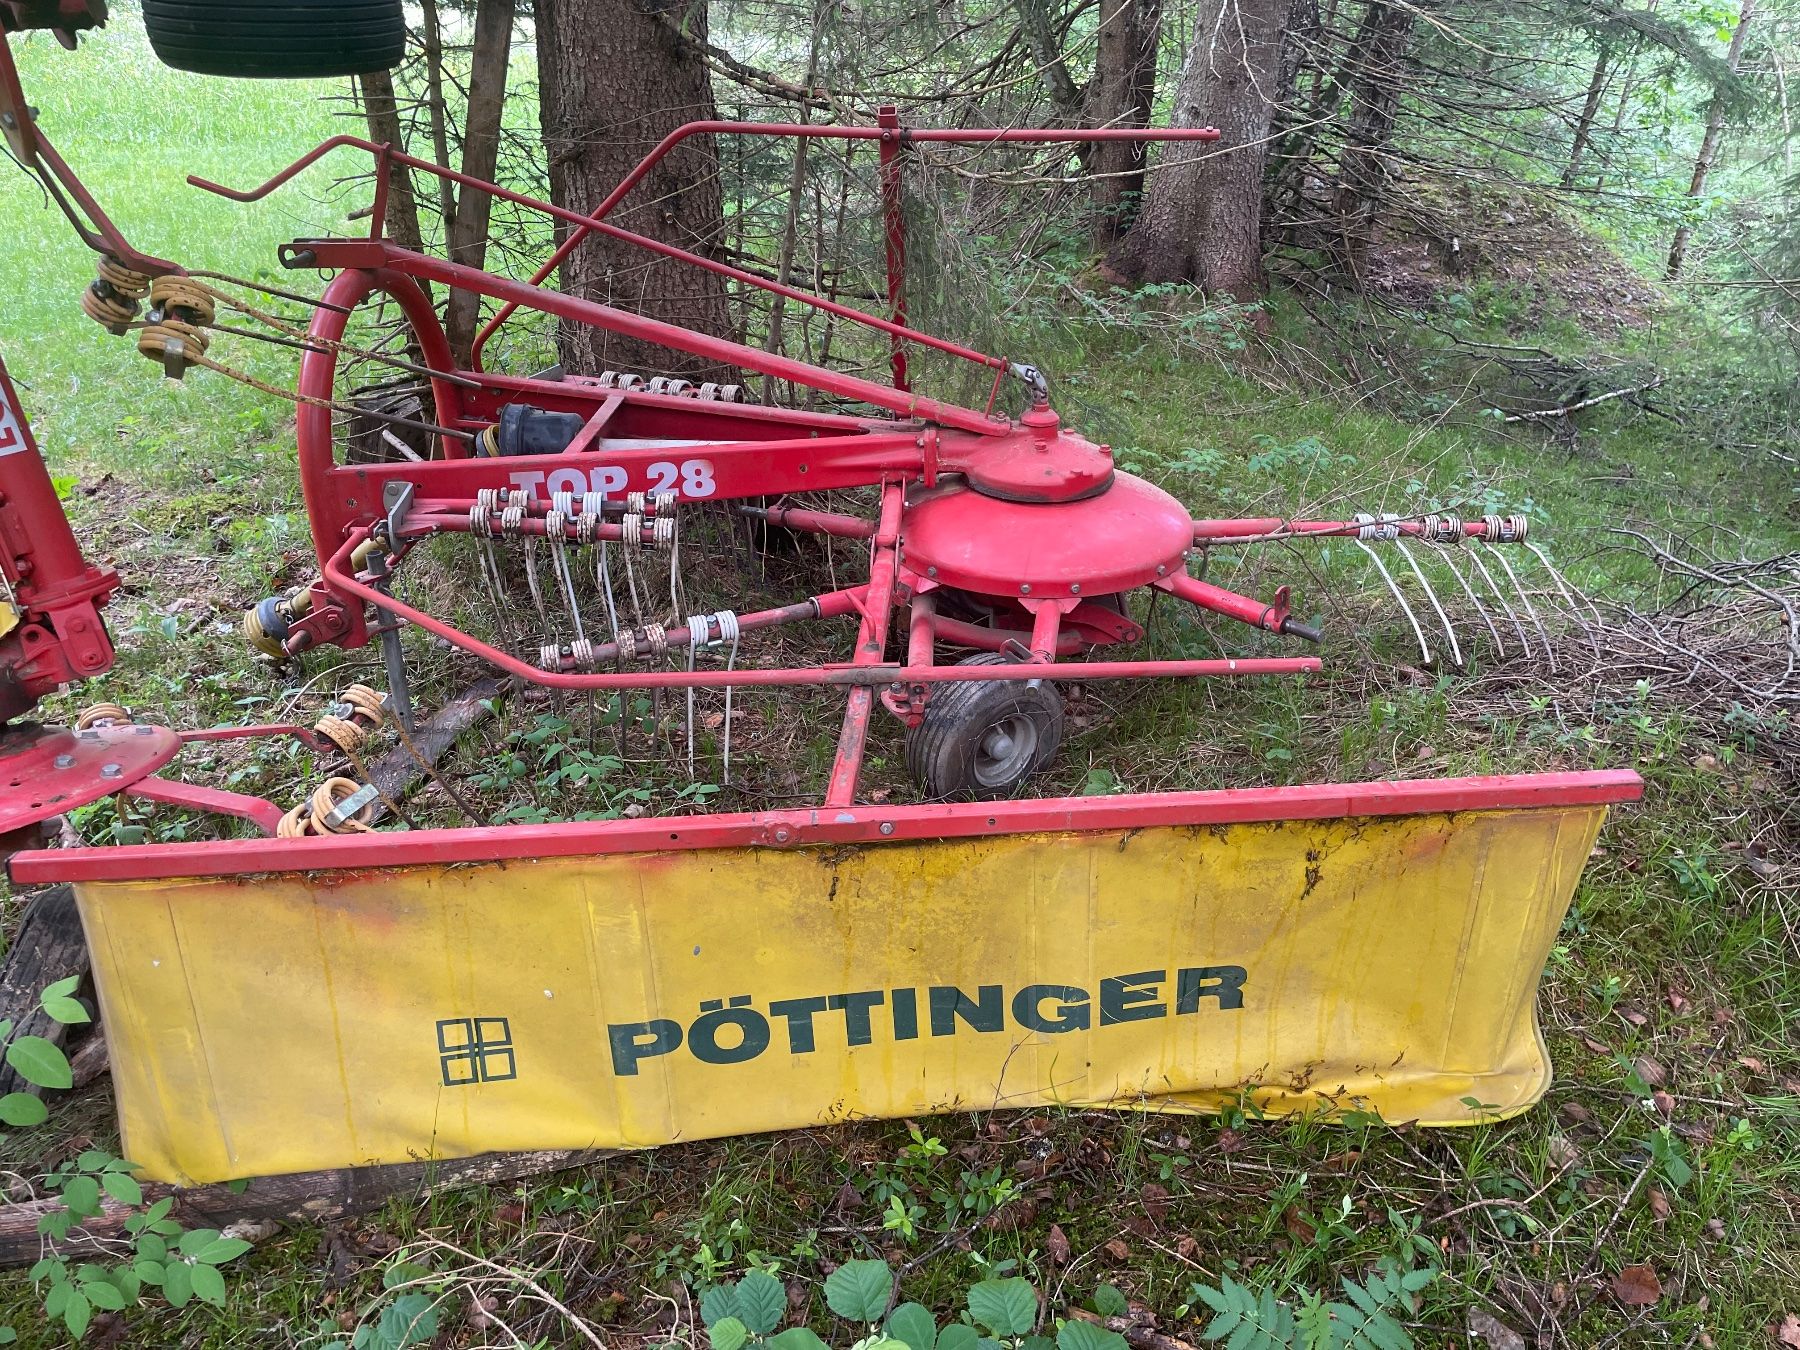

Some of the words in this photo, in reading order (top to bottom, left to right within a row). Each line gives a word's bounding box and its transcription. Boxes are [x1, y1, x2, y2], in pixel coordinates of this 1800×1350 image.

[509, 465, 629, 501] TOP
[646, 459, 716, 498] 28
[607, 965, 1248, 1076] PÖTTINGER
